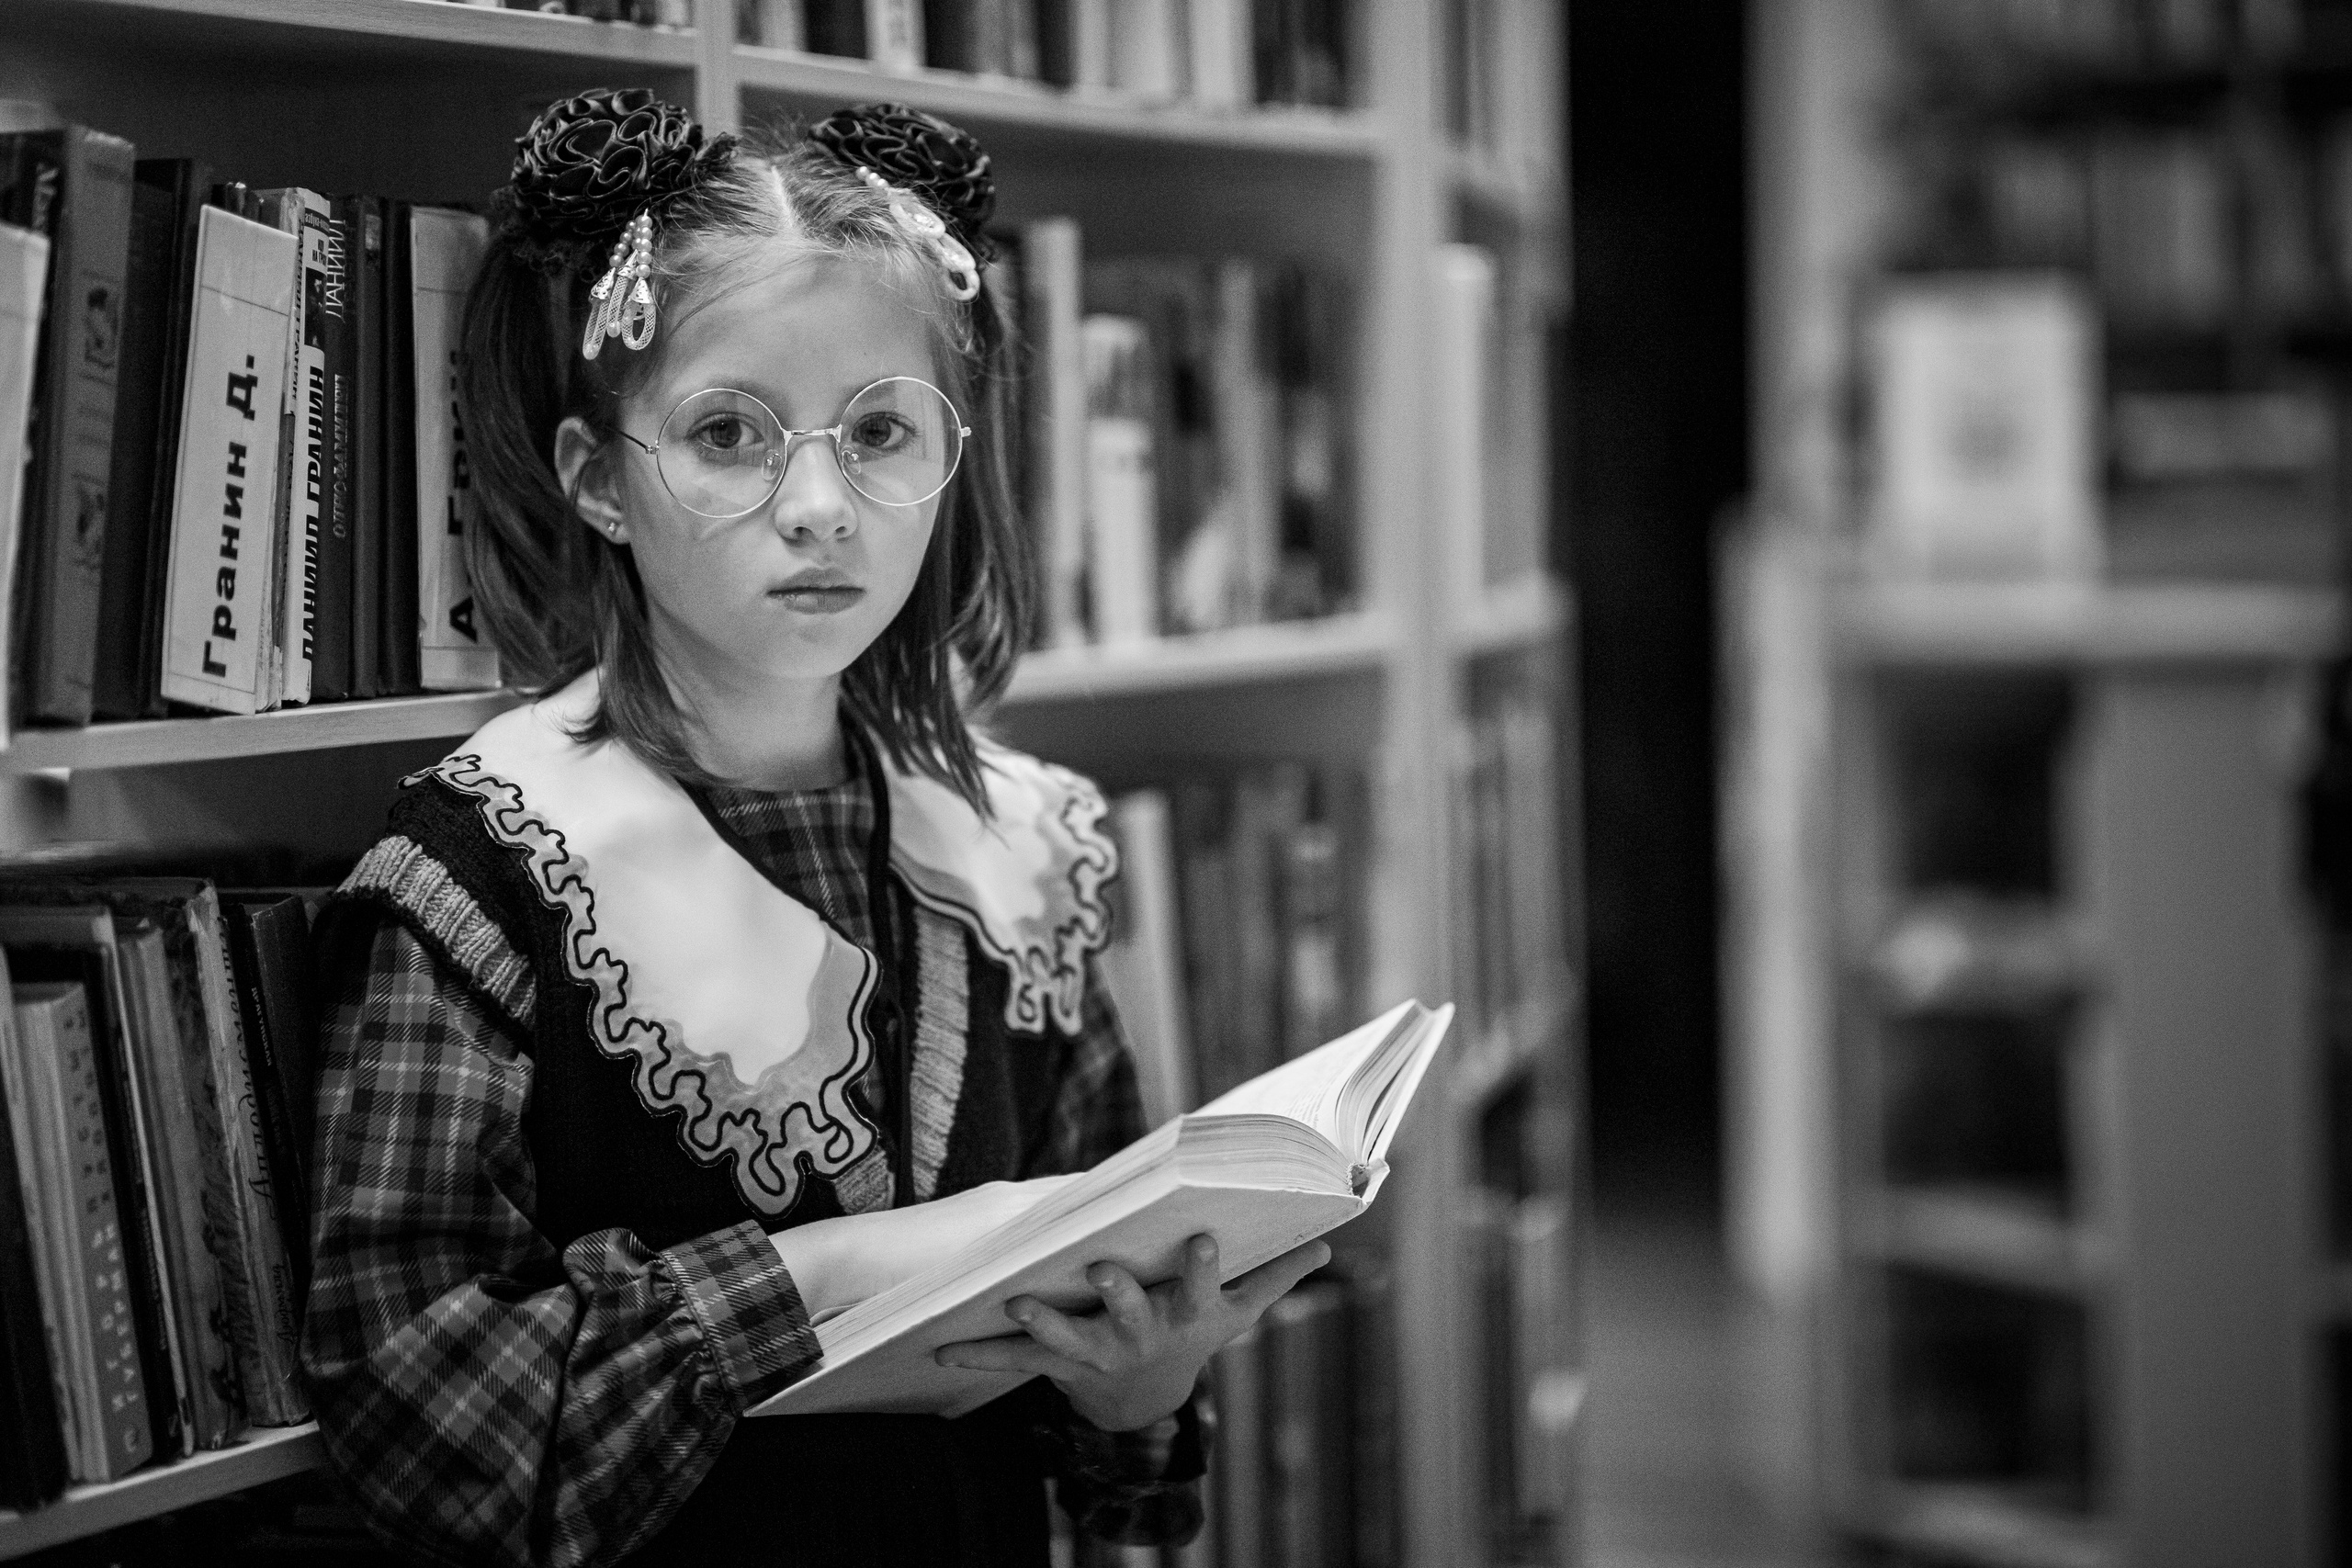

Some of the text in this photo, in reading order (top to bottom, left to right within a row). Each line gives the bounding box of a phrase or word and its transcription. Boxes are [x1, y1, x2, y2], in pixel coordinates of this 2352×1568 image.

[324, 219, 346, 322] ДАНИИЛ
[201, 354, 258, 679] Гранин Д.
[302, 365, 324, 660] ДАНИИЛ ГРАНИН
[251, 987, 273, 1067] ДРАГУНСКАЯ
[104, 1222, 139, 1404] ГУБЕРМАН
